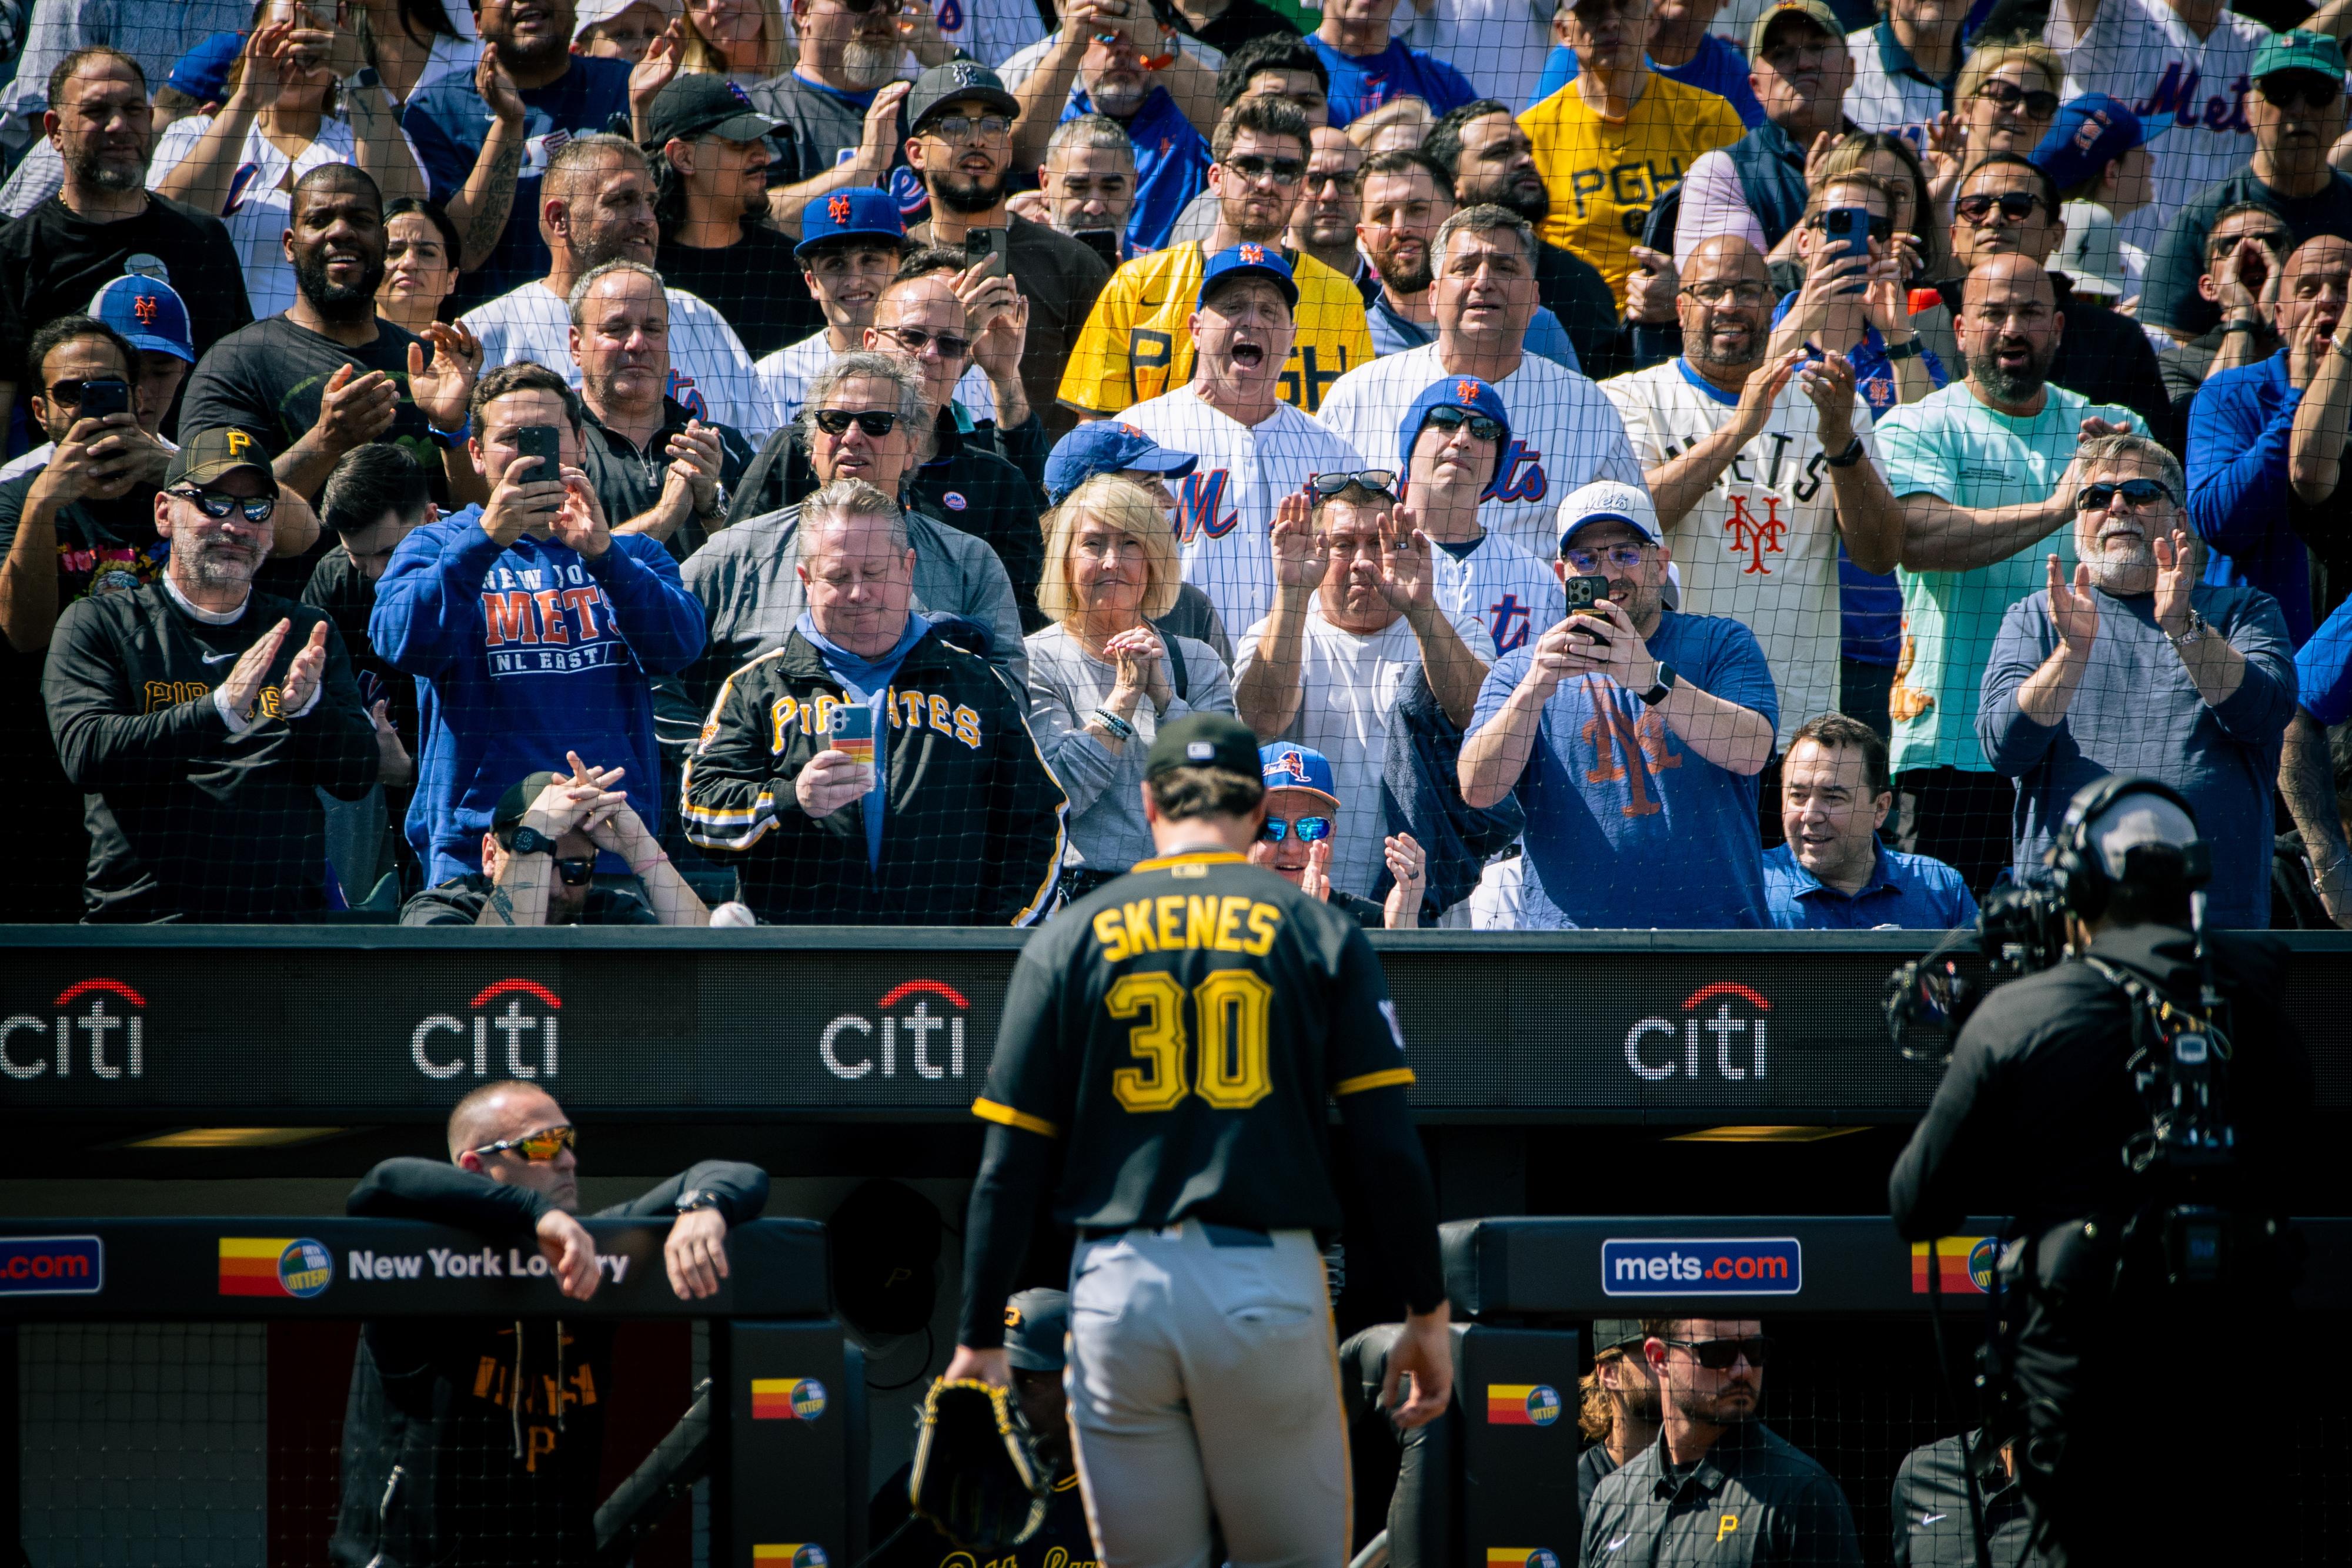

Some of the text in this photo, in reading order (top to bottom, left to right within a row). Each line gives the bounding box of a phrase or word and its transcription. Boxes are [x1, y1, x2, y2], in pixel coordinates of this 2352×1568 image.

[2134, 62, 2251, 133] Met
[1572, 157, 1683, 219] PGH
[227, 432, 251, 456] P
[1576, 489, 1628, 517] Mets
[497, 648, 597, 671] NL EAST
[1093, 895, 1282, 962] SKENES
[0, 998, 143, 1079] citi
[412, 1001, 559, 1079] citi
[820, 1002, 965, 1079] citi
[1104, 969, 1274, 1113] 30
[1625, 1004, 1766, 1081] citi
[349, 1247, 630, 1283] New York Lory
[1615, 1252, 1788, 1280] mets.com
[526, 1425, 555, 1472] P
[1717, 1514, 1739, 1543] P
